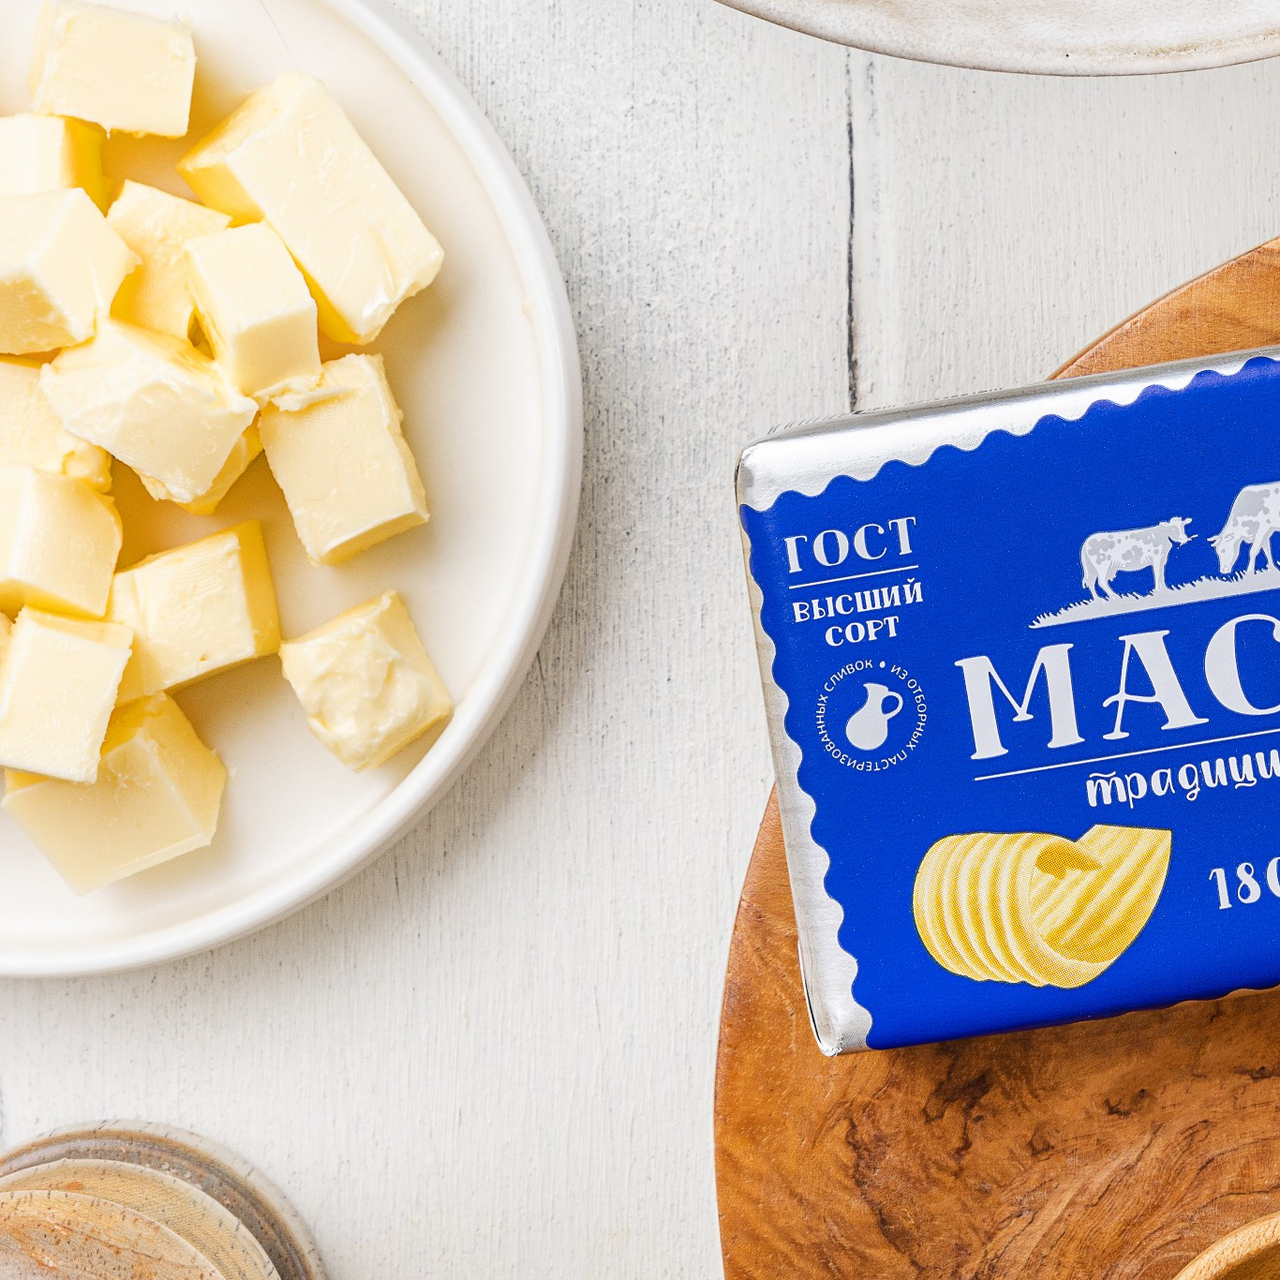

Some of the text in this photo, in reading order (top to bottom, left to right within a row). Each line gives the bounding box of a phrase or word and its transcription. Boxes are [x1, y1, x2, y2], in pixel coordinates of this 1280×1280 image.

[784, 516, 917, 573] ГОСТ
[792, 577, 924, 623] ВЫСШИЙ
[825, 615, 899, 647] СОРТ
[815, 659, 928, 772] ИЗ ОТБОРНЫХ ПАСТЕРИЗОВАННЫХ СЛИВОК
